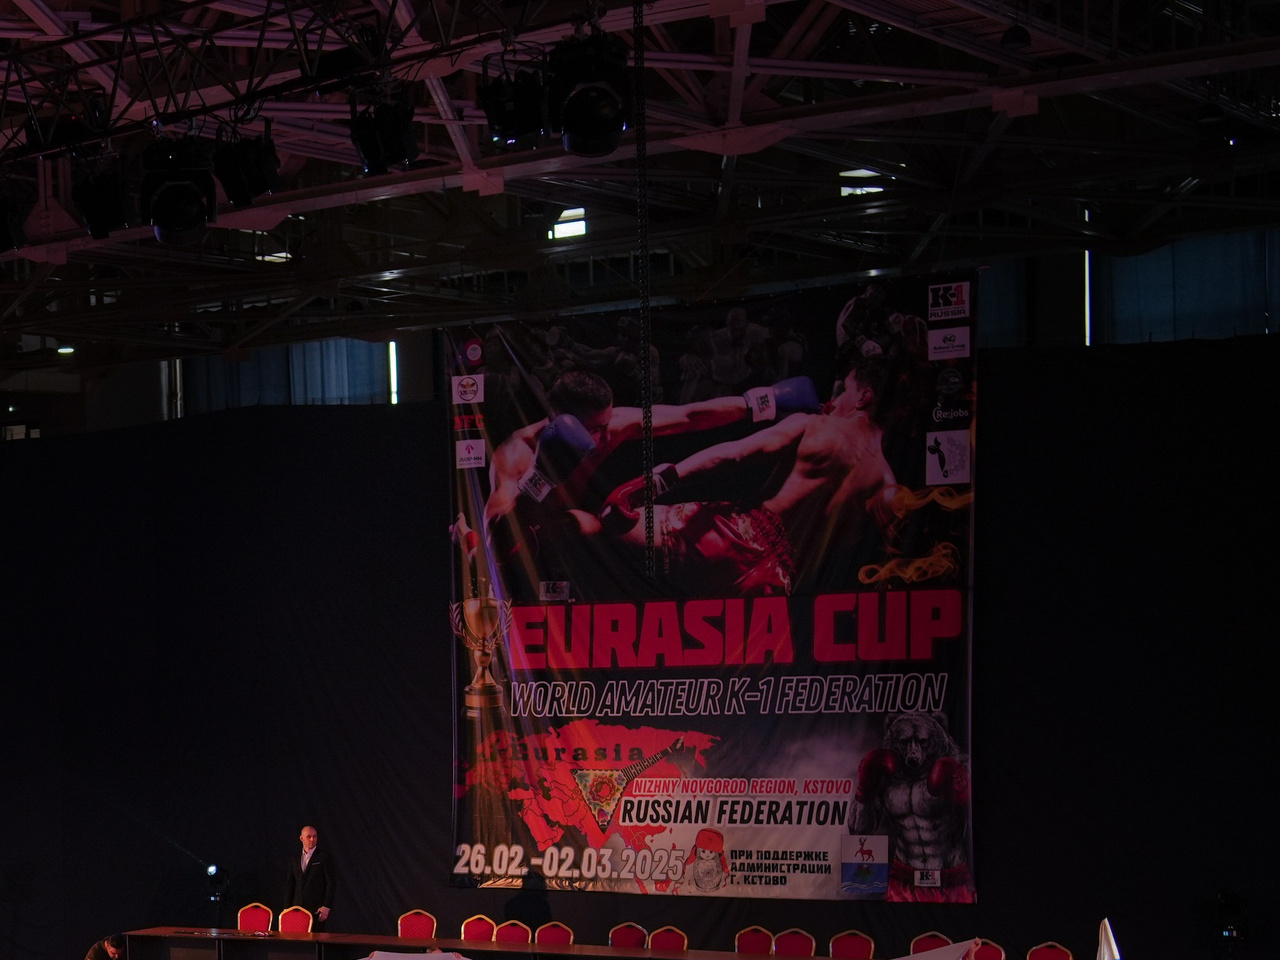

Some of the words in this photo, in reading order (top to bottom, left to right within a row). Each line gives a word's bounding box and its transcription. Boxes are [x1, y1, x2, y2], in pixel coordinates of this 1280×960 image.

[930, 284, 966, 308] K-1
[930, 309, 966, 318] RUSSIA
[511, 597, 794, 669] EURASIA
[814, 589, 963, 662] CUP
[510, 680, 600, 717] WORLD
[598, 678, 724, 716] AMATEUR
[725, 676, 775, 715] K-1
[775, 673, 948, 713] FEDERATION
[633, 779, 680, 793] NIZHNY
[681, 779, 747, 794] NOVGOROD
[751, 780, 798, 796] REGION,
[803, 780, 852, 794] KSTOVO
[622, 800, 710, 824] RUSSIAN
[717, 800, 848, 825] FEDERATION
[730, 850, 753, 861] ПРИ
[756, 850, 829, 862] ПОДДЕРЖКЕ
[730, 862, 832, 874] АДМИНИСТРАЦИИ
[744, 875, 787, 886] КСТОВО
